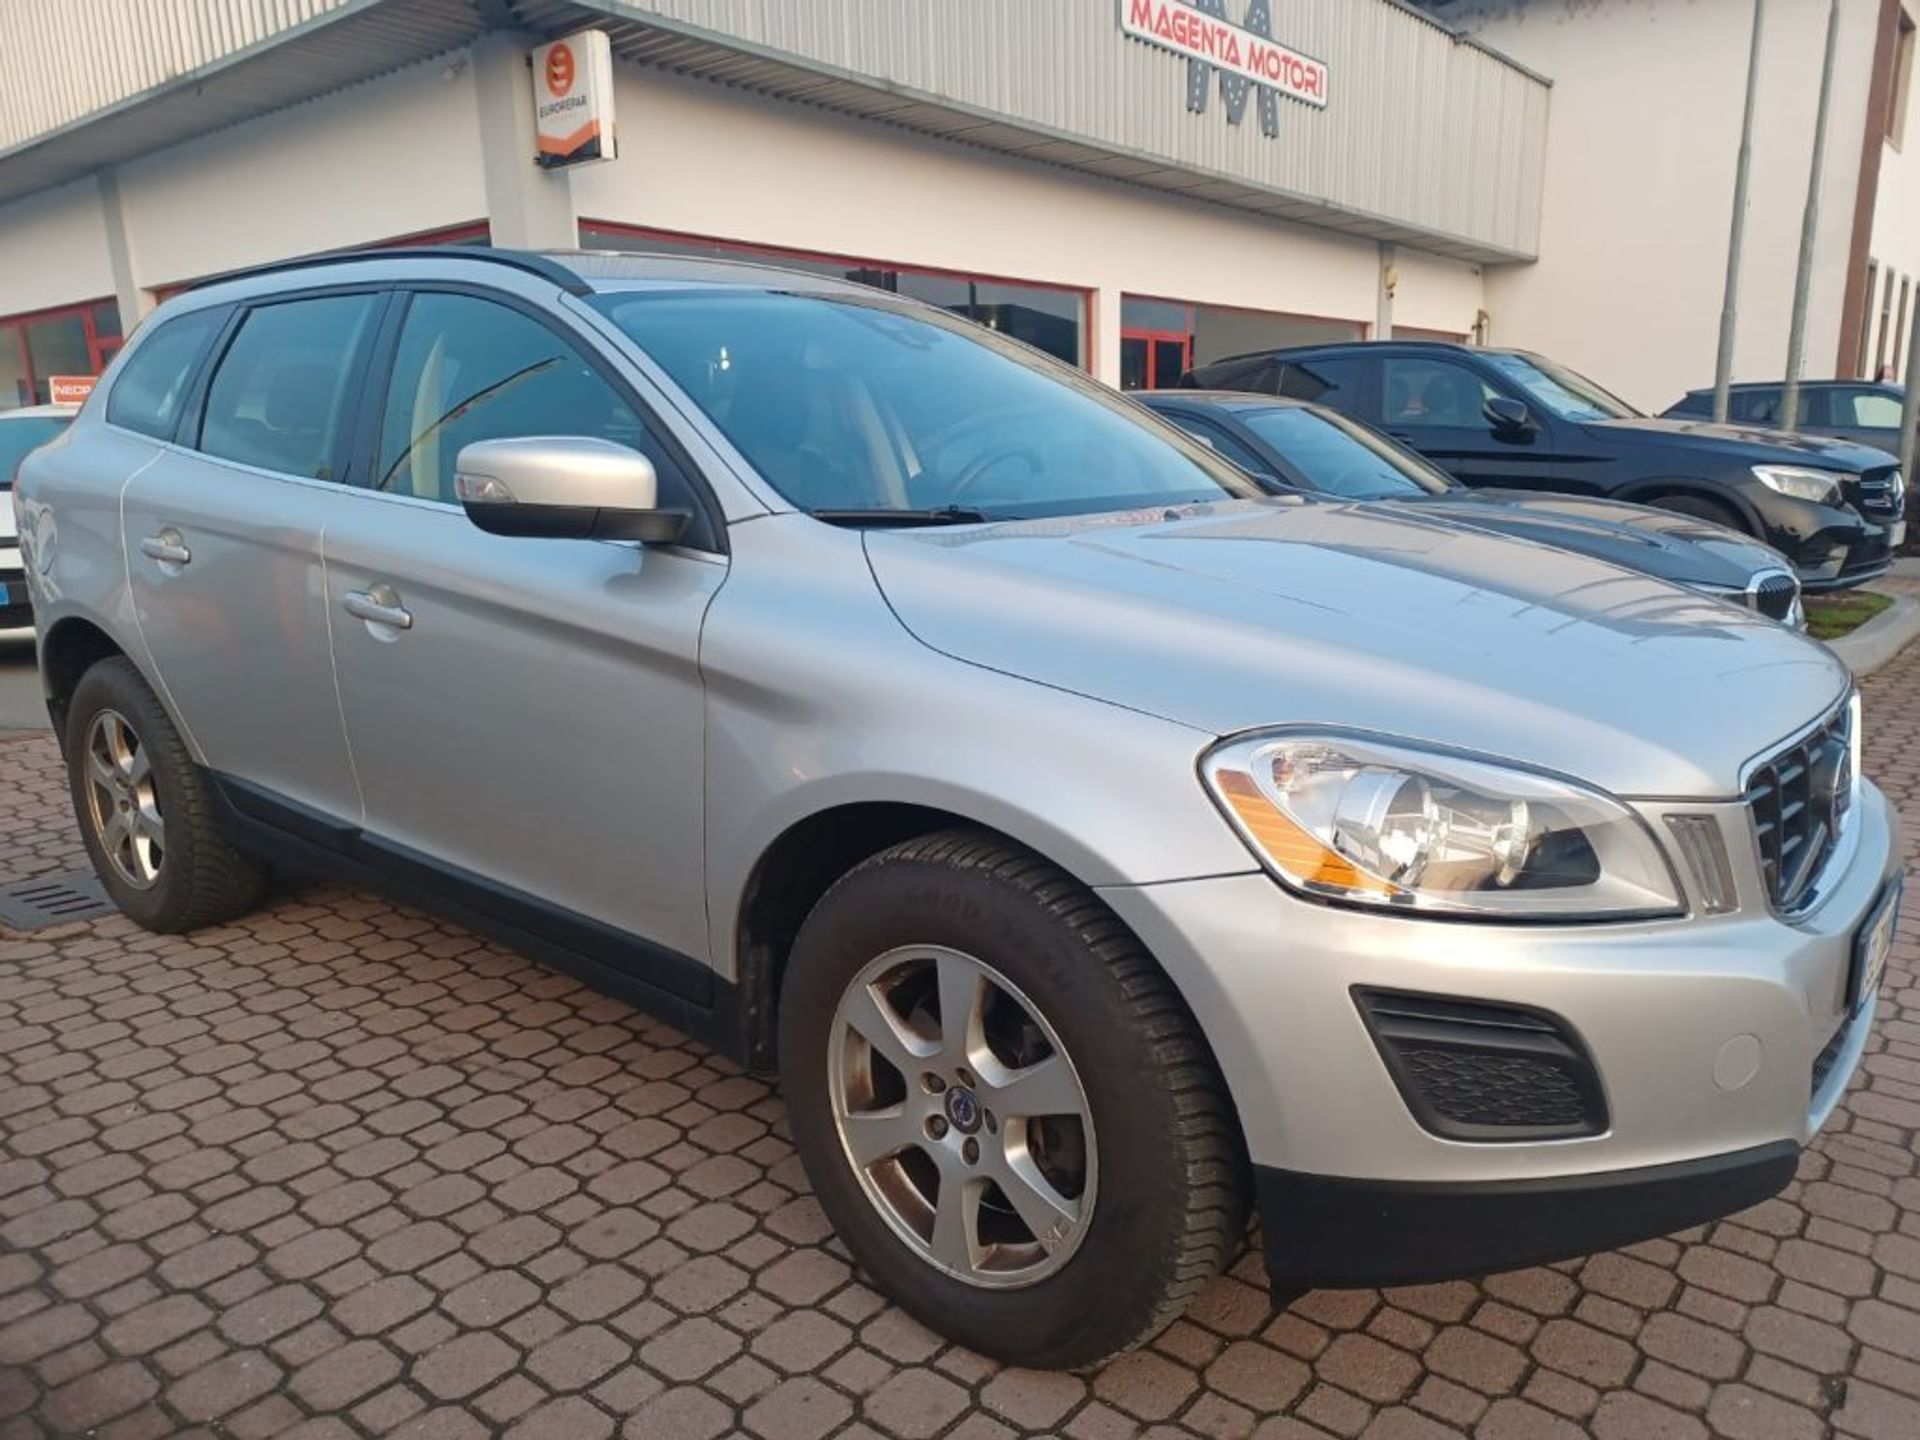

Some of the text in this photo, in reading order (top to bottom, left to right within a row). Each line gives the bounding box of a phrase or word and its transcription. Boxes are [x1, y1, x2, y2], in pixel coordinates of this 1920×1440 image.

[1130, 0, 1324, 97] MAGENTA MOTORI
[539, 95, 587, 118] EUROREPAR
